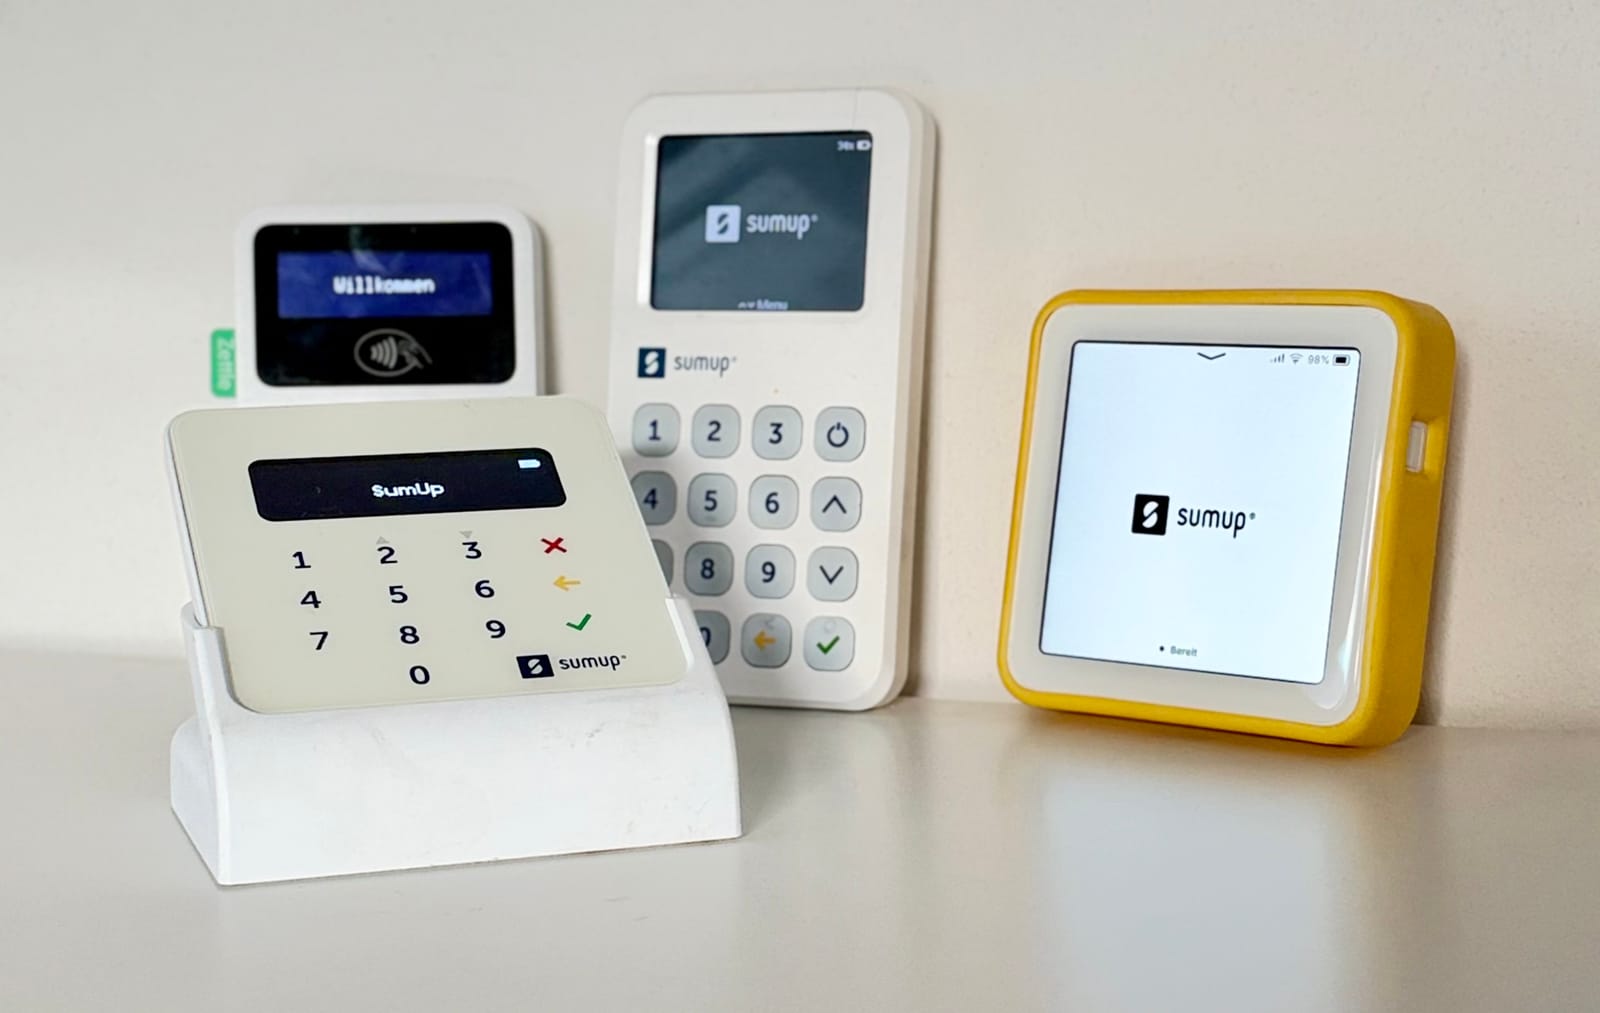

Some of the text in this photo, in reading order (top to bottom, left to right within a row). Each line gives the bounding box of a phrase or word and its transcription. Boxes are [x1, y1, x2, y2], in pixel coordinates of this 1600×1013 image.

[745, 213, 811, 240] sumup
[333, 275, 435, 294] Willkommen
[756, 299, 788, 310] Menu
[673, 354, 730, 377] sumup
[1307, 354, 1330, 365] 98%
[648, 419, 784, 445] 1 2 3
[371, 482, 445, 499] SumUp
[643, 488, 779, 514] 4 5 6
[1177, 507, 1247, 538] sumup
[292, 541, 482, 569] 1 2 3
[700, 558, 776, 583] 8 9
[300, 580, 495, 609] 4 5 6
[310, 619, 506, 650] 7 8 9
[559, 655, 621, 671] sumup
[1170, 646, 1198, 657] Bereit
[409, 665, 431, 686] 0
